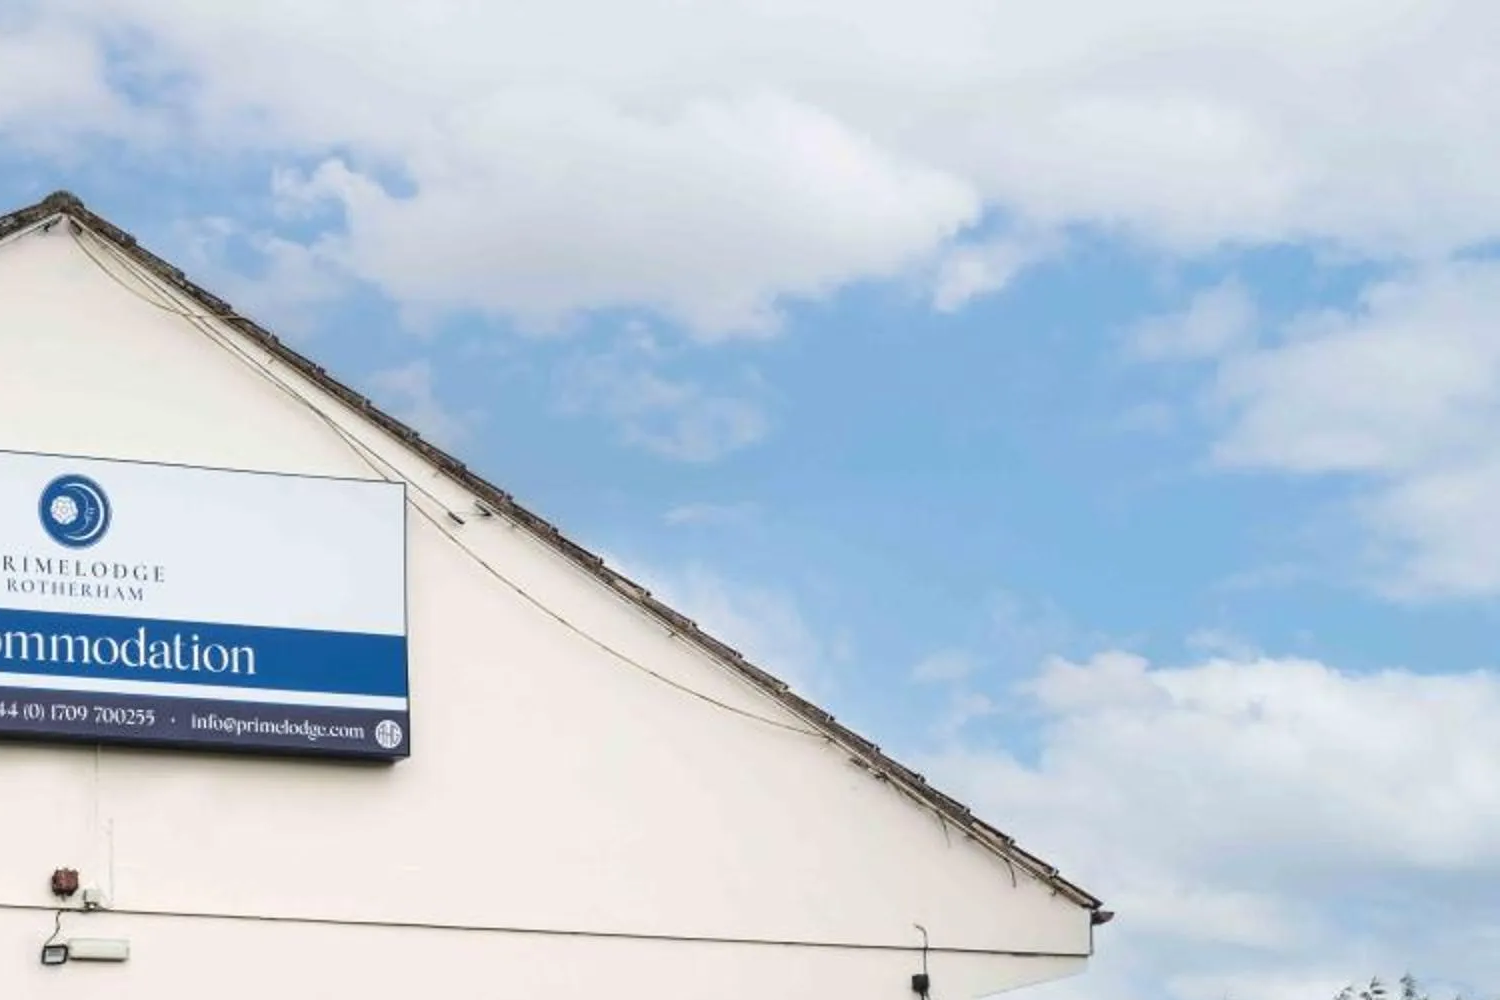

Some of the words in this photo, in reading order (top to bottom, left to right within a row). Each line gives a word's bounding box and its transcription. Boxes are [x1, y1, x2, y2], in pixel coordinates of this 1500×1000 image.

[6, 577, 144, 602] ROTHERHAM
[23, 703, 45, 721] (0)
[51, 704, 89, 721] 1709
[93, 706, 156, 726] 700255
